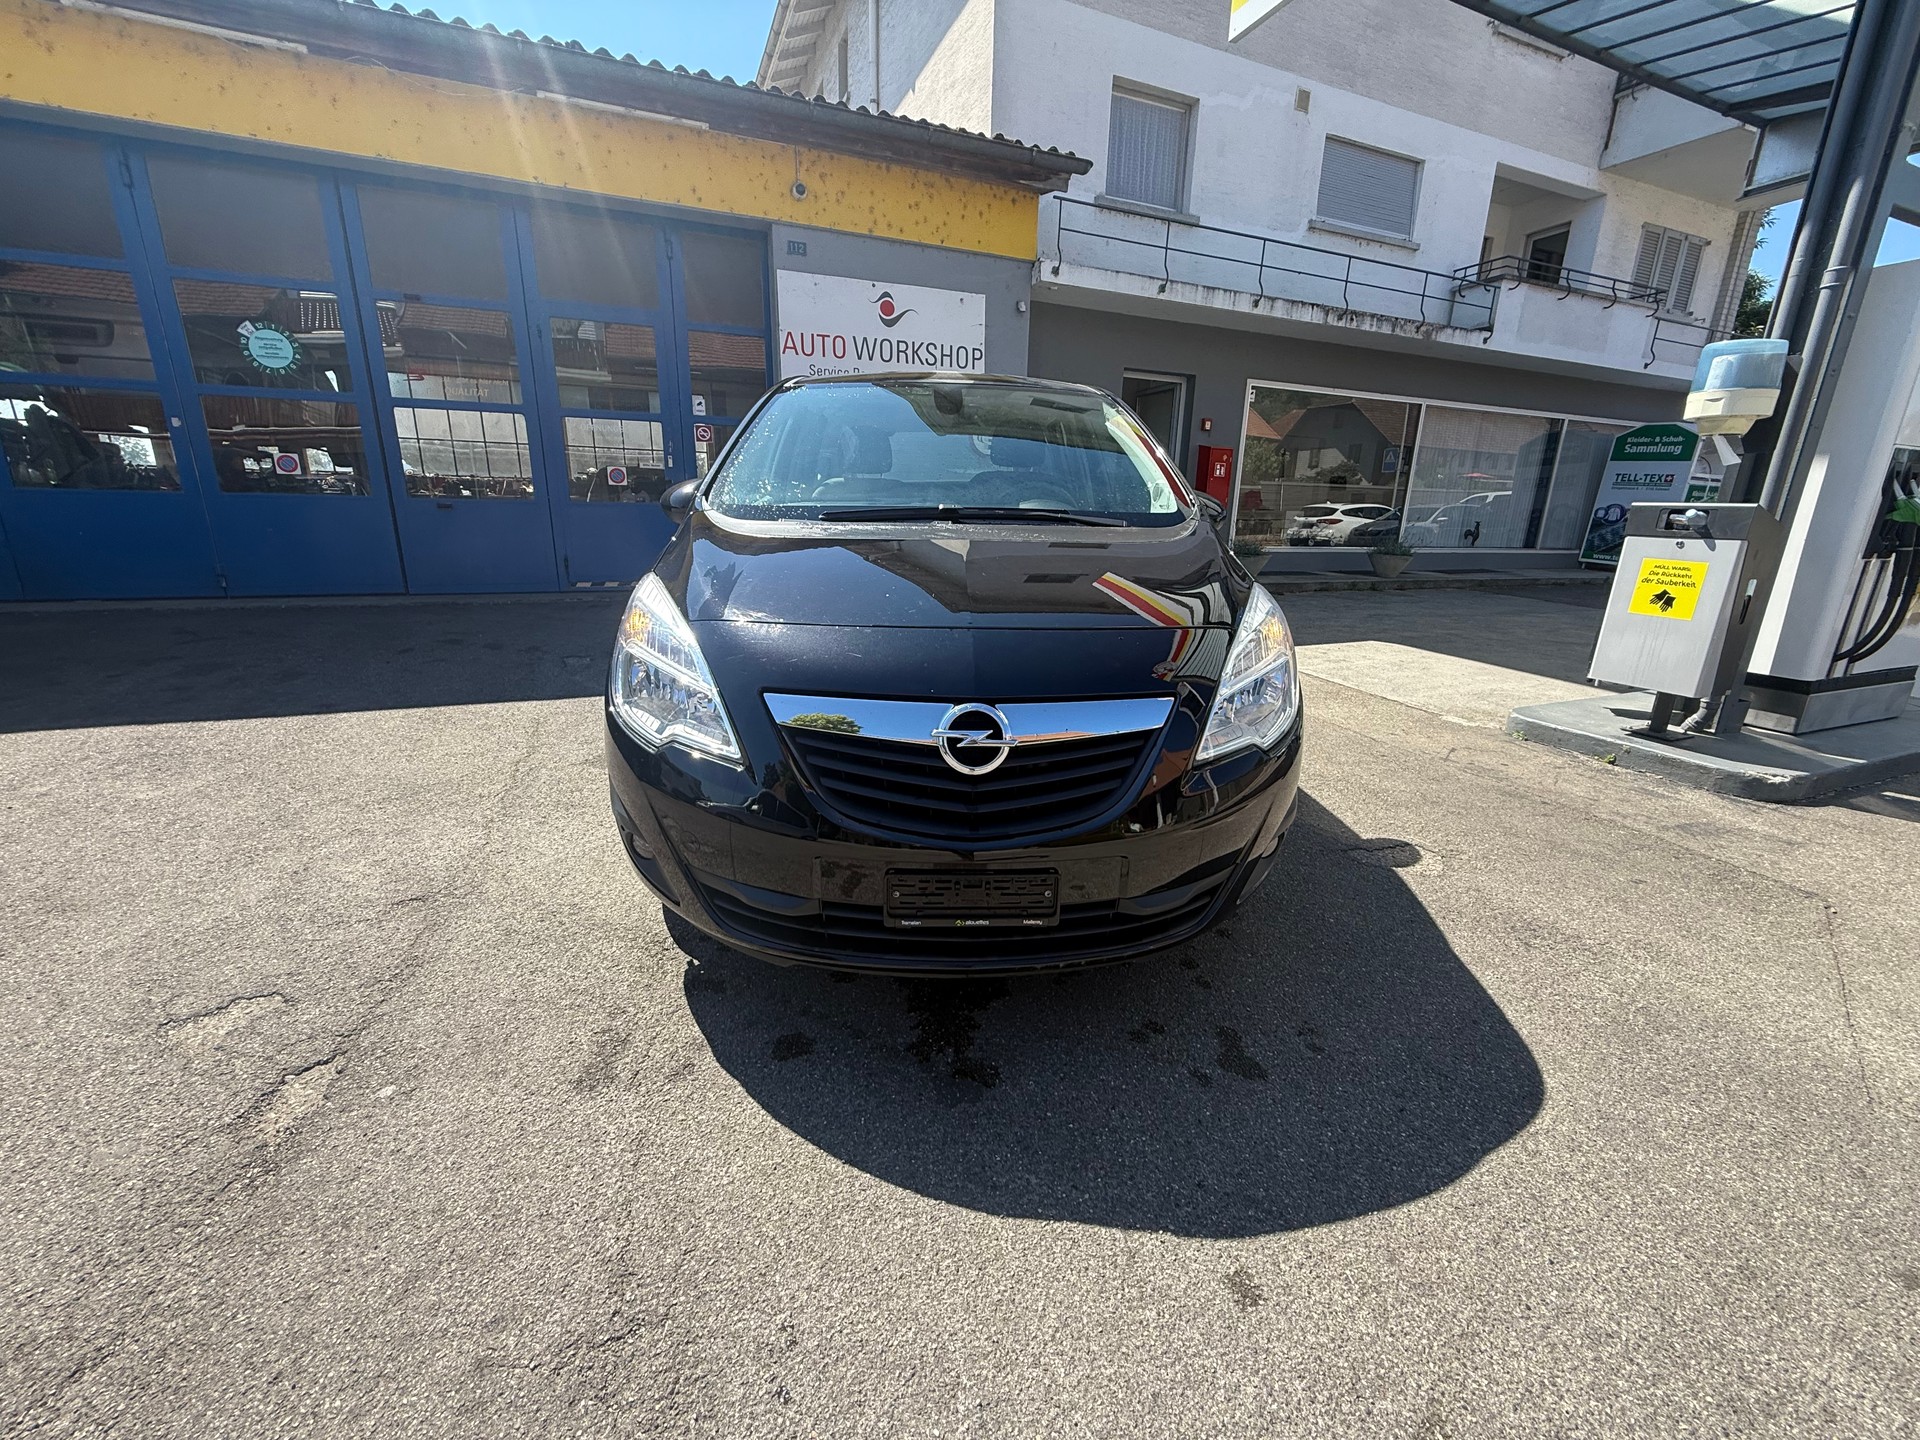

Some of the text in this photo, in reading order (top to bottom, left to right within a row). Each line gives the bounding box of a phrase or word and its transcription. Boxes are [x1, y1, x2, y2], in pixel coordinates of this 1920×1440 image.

[790, 242, 804, 253] 112
[782, 331, 983, 370] AUTO WORKSHOP
[1624, 443, 1683, 455] Sammlung
[1615, 473, 1665, 482] TELL-TEX
[1661, 571, 1692, 579] Rückkehr
